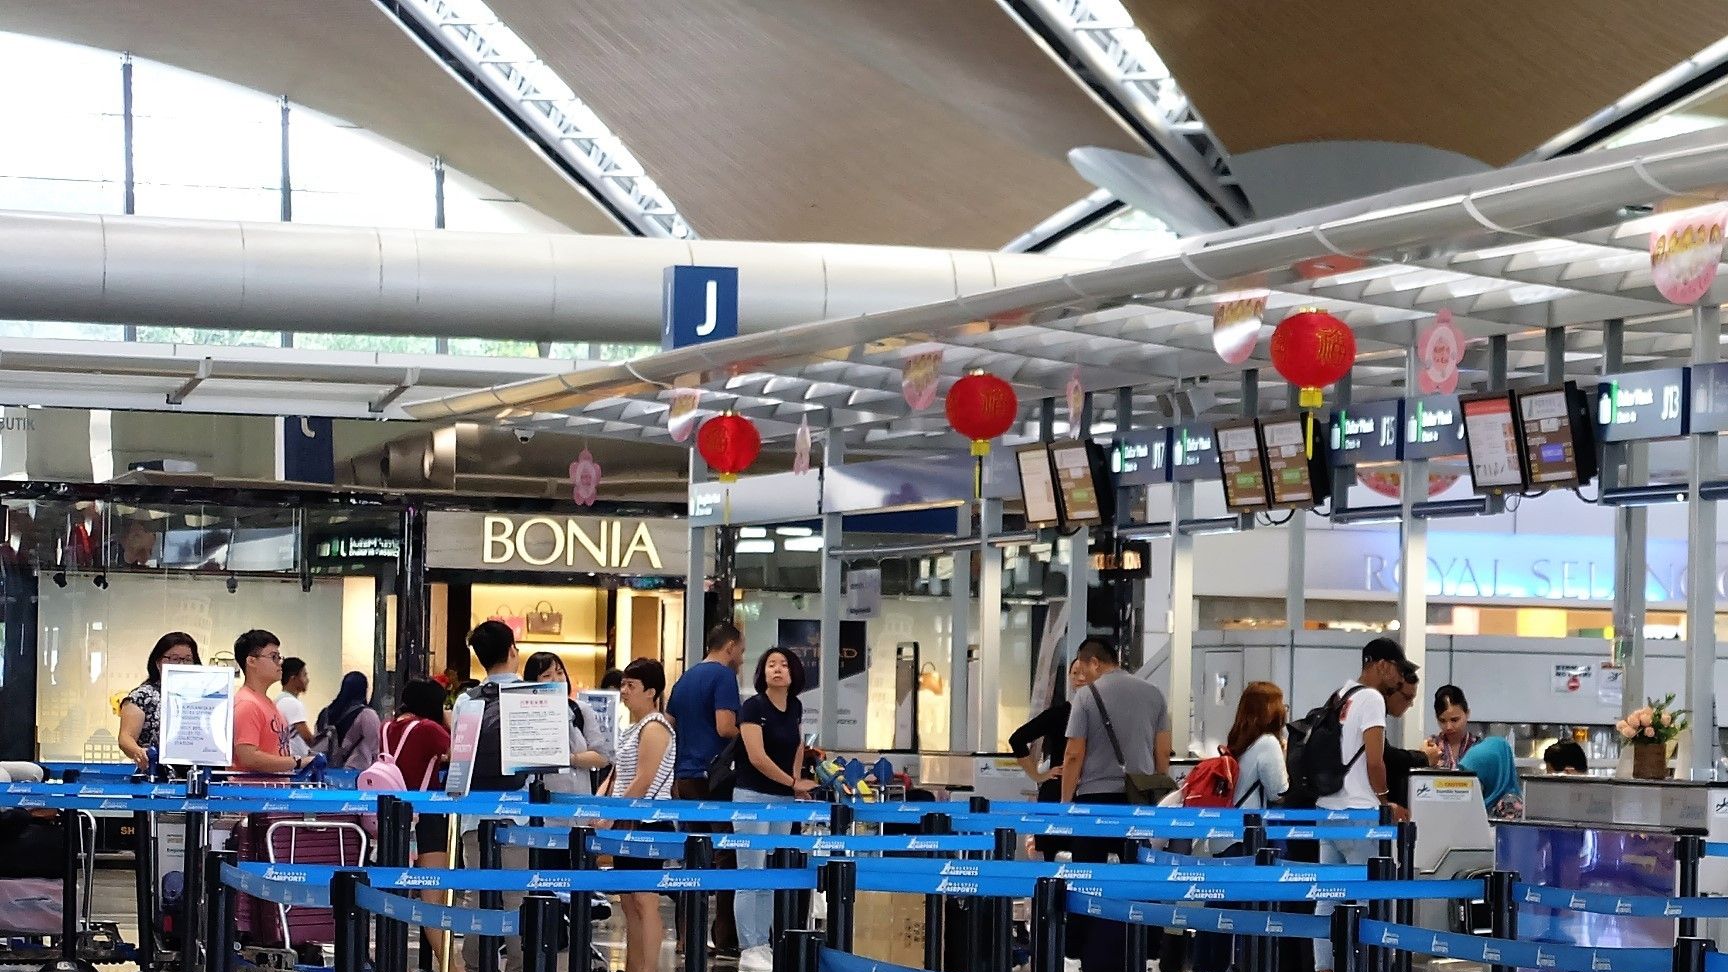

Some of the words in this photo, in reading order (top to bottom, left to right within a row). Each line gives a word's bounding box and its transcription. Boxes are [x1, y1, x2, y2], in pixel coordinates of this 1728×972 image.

[696, 281, 717, 336] J
[483, 516, 663, 569] BONIA
[1363, 553, 1524, 600] RYAL
